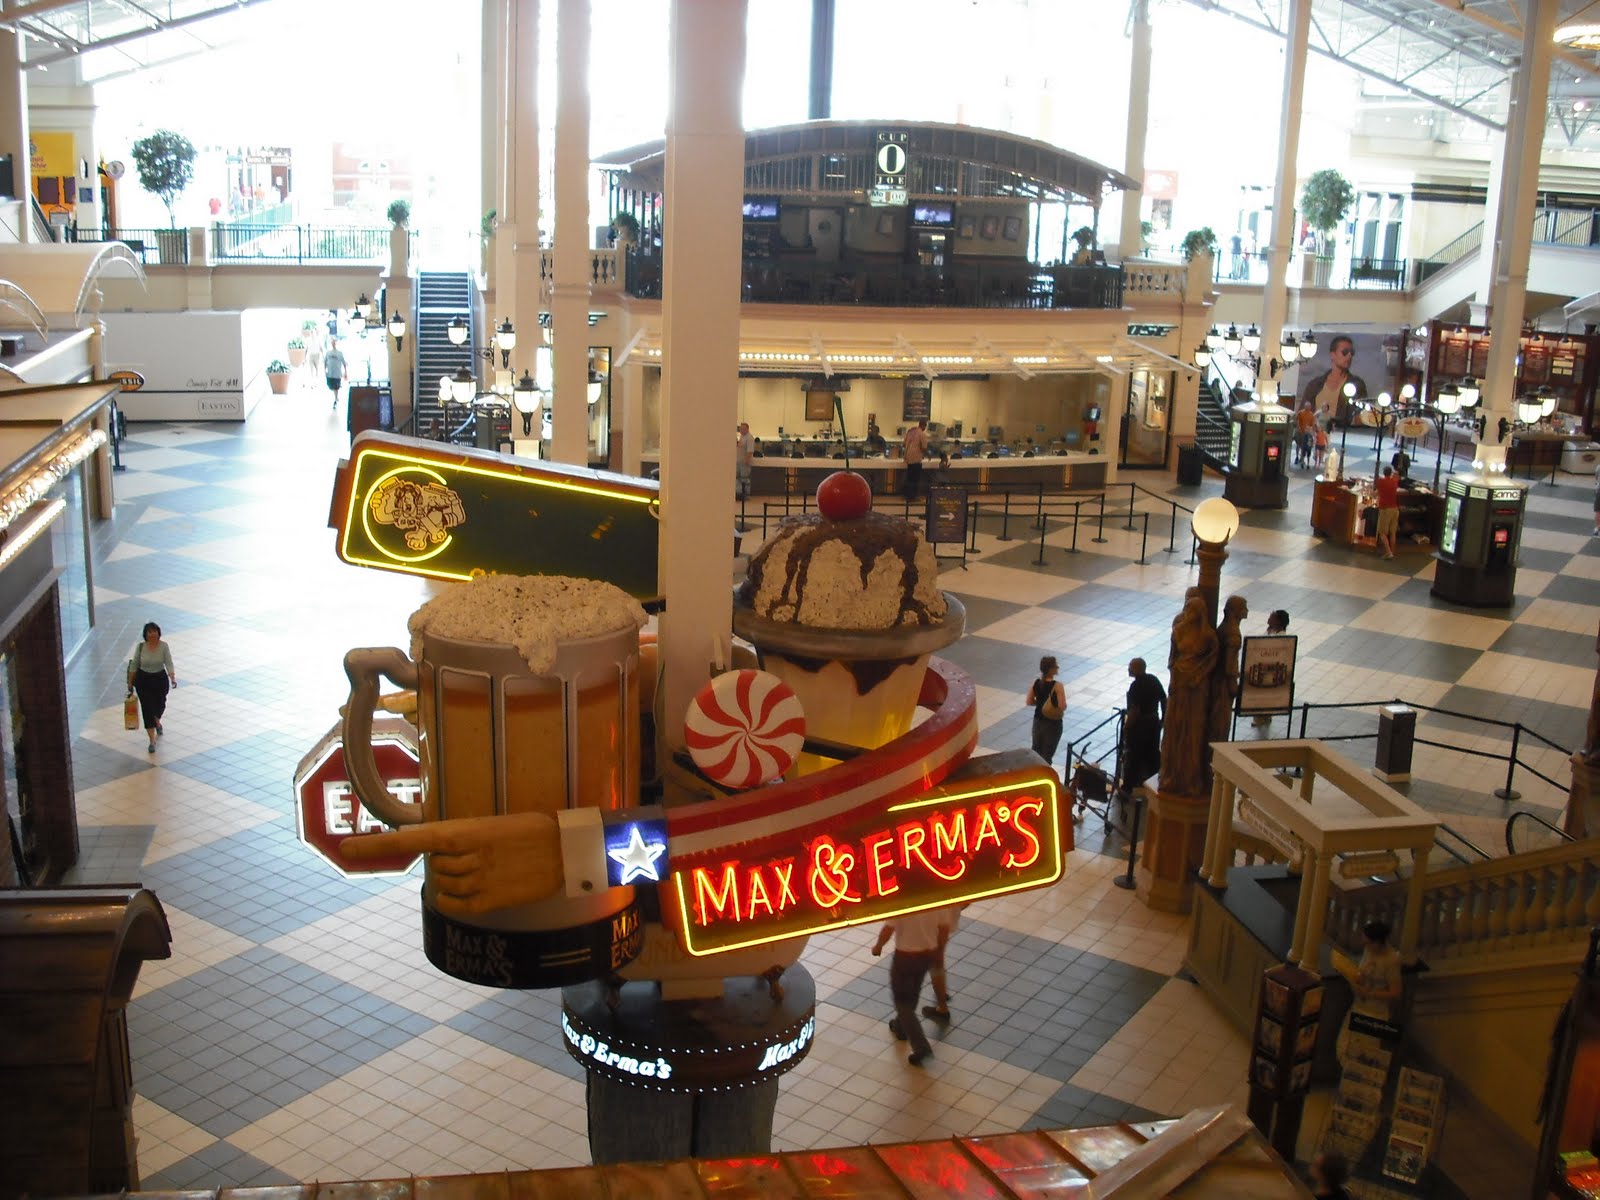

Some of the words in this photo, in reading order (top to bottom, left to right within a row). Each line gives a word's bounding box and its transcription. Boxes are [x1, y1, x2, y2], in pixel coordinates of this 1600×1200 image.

[878, 133, 907, 142] CUP
[878, 143, 906, 174] O
[877, 176, 905, 185] JOE
[1127, 324, 1179, 337] OSE
[201, 401, 237, 410] EASTON
[1493, 490, 1520, 499] amc
[322, 778, 421, 836] EAT
[692, 856, 799, 927] MAX
[803, 834, 862, 909] &
[860, 797, 1043, 898] ERMA'S
[446, 924, 483, 953] MAX
[612, 908, 641, 943] MAX
[611, 931, 641, 968] ERM
[446, 949, 514, 987] ERMA'S
[561, 1011, 581, 1048] Max
[593, 1041, 673, 1080] Erma's
[757, 1038, 799, 1071] Max
